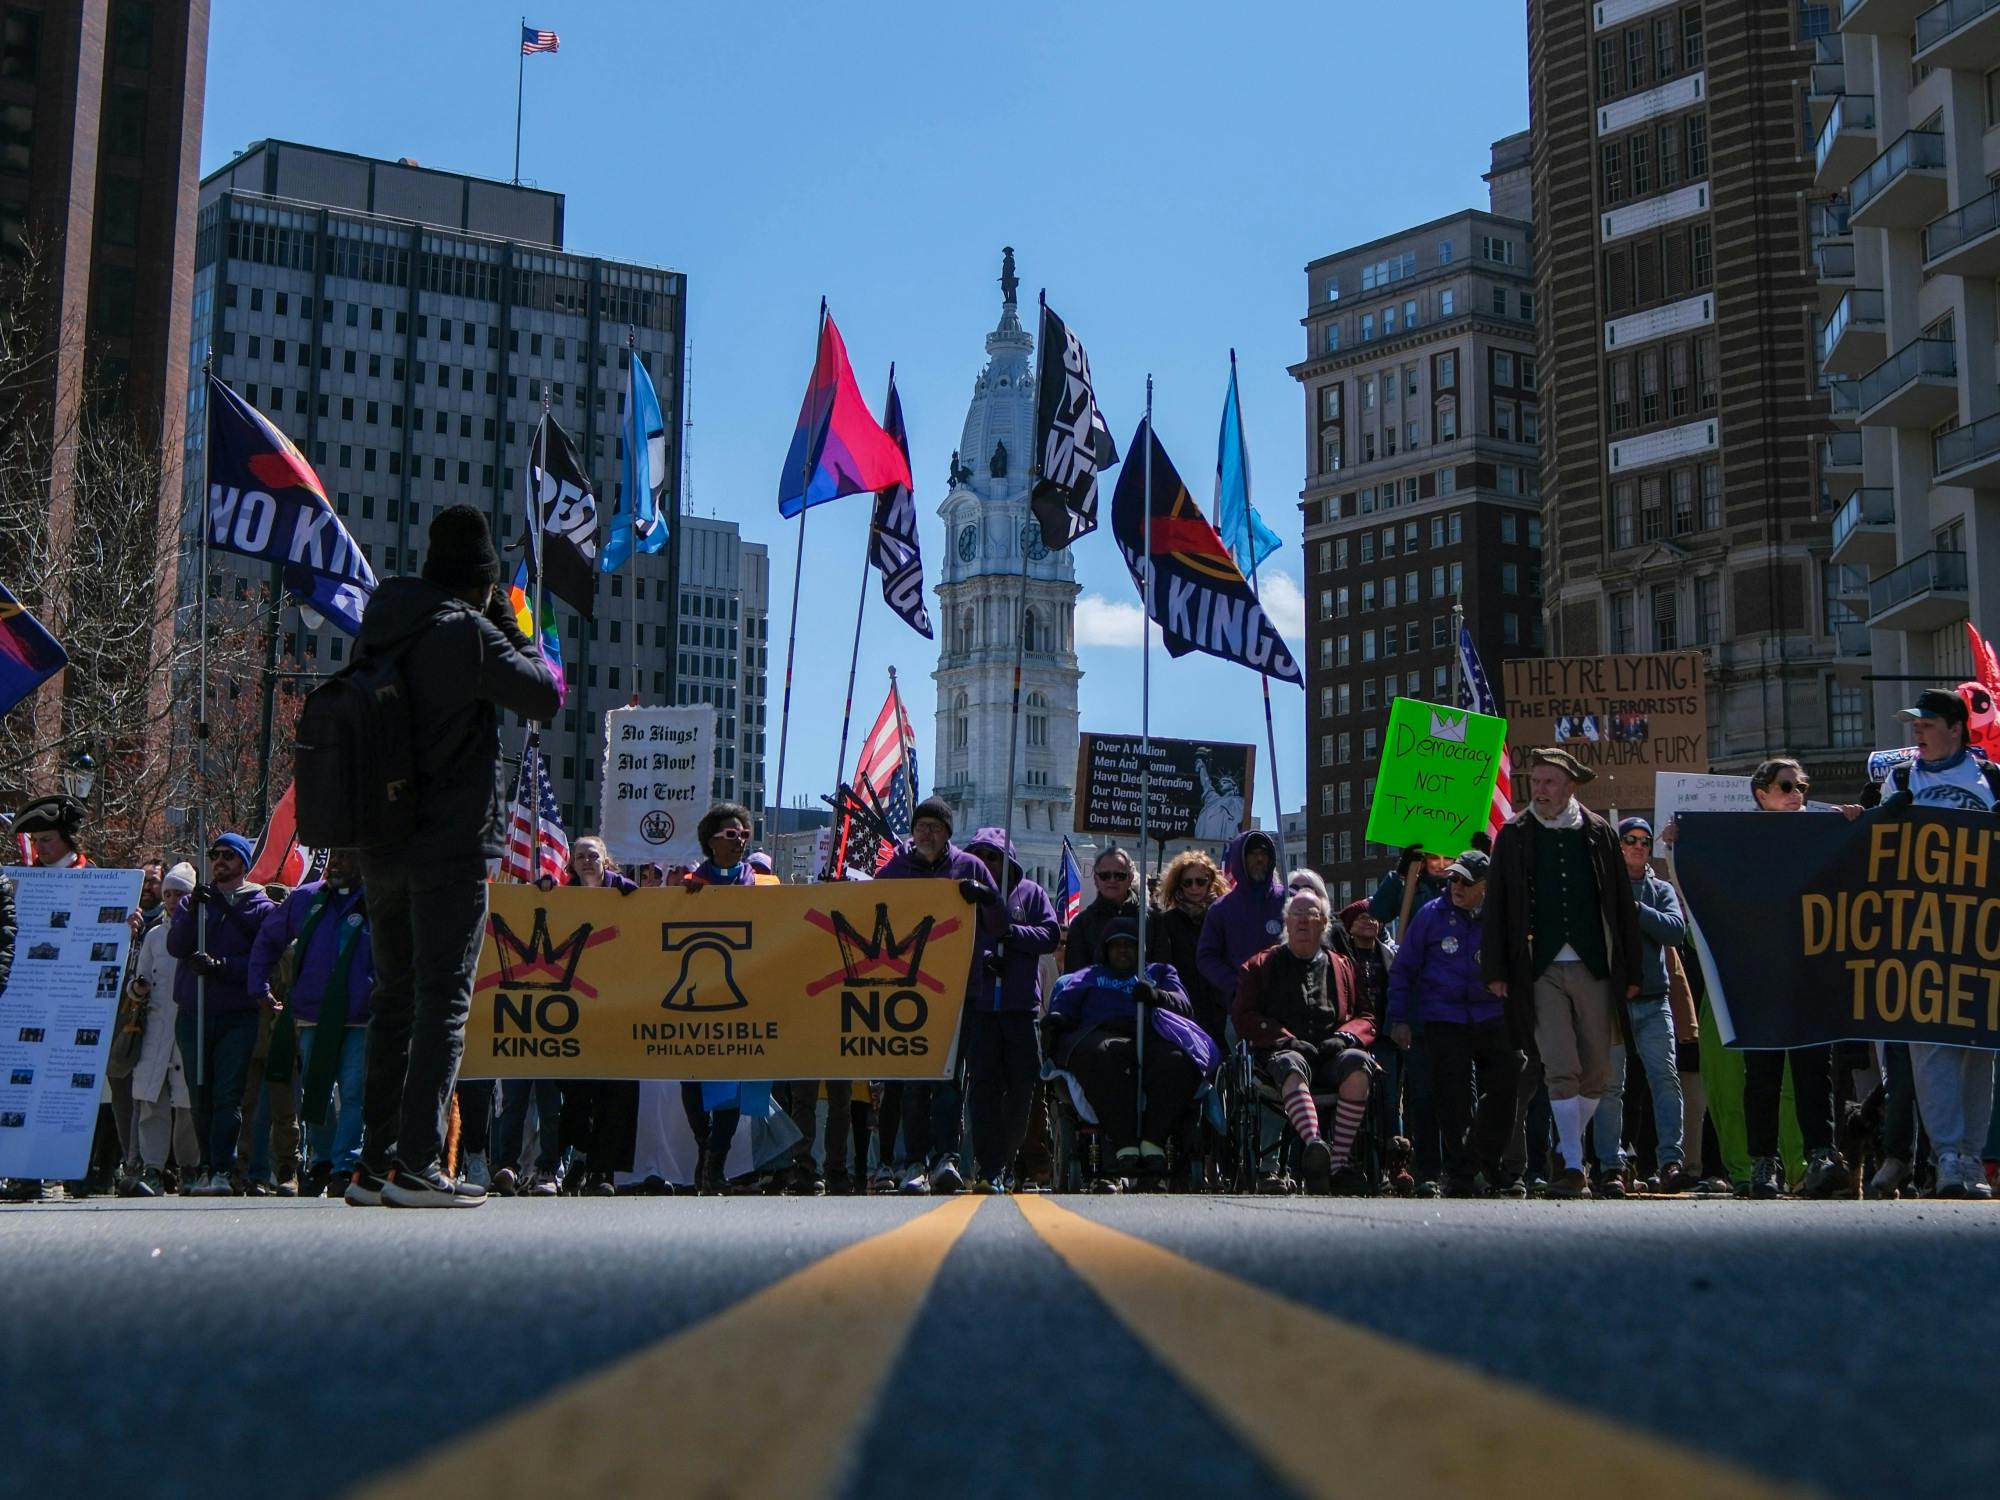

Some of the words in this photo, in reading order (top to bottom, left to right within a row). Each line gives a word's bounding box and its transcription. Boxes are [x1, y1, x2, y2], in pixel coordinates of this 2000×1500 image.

[208, 483, 277, 552] NO
[1613, 656, 1697, 691] LYING!
[1505, 700, 1545, 717] THE
[1549, 699, 1594, 717] REAL
[1600, 696, 1697, 715] TERRORISTS
[621, 724, 645, 741] No
[649, 725, 698, 745] Kings!
[1097, 741, 1121, 754] Over
[1123, 743, 1131, 754] A
[1605, 740, 1650, 765] AIPAC
[1654, 734, 1702, 765] FURY
[617, 753, 649, 771] Not
[652, 753, 696, 771] Now!
[1095, 756, 1116, 769] Men
[1118, 758, 1138, 770] And
[1149, 760, 1176, 773] omen
[1094, 770, 1119, 783] Have
[1121, 773, 1142, 784] Died
[1414, 769, 1455, 794] NOT
[1677, 778, 1688, 788] IT
[617, 782, 649, 801] Not
[653, 782, 696, 801] Ever!
[1093, 784, 1111, 796] Our
[1091, 799, 1109, 810] Are
[1111, 800, 1127, 811] We
[1130, 802, 1157, 816] Gong
[1161, 804, 1170, 815] To
[1174, 807, 1190, 817] Let
[1385, 794, 1470, 836] Tyranny
[1090, 813, 1109, 824] One
[1111, 815, 1131, 826] Man
[1135, 817, 1172, 831] Dstroy
[1175, 819, 1189, 831] It?
[1867, 822, 2000, 888] FIGH
[1801, 889, 2000, 961] DICTATO
[1845, 958, 2000, 1031] TOGET
[493, 993, 579, 1035] NO
[841, 990, 928, 1033] NO
[632, 1022, 779, 1040] INDIVISIBLE
[492, 1037, 581, 1057] KINGS
[646, 1044, 765, 1056] PHILADELPHIA
[840, 1036, 929, 1057] KINGS
